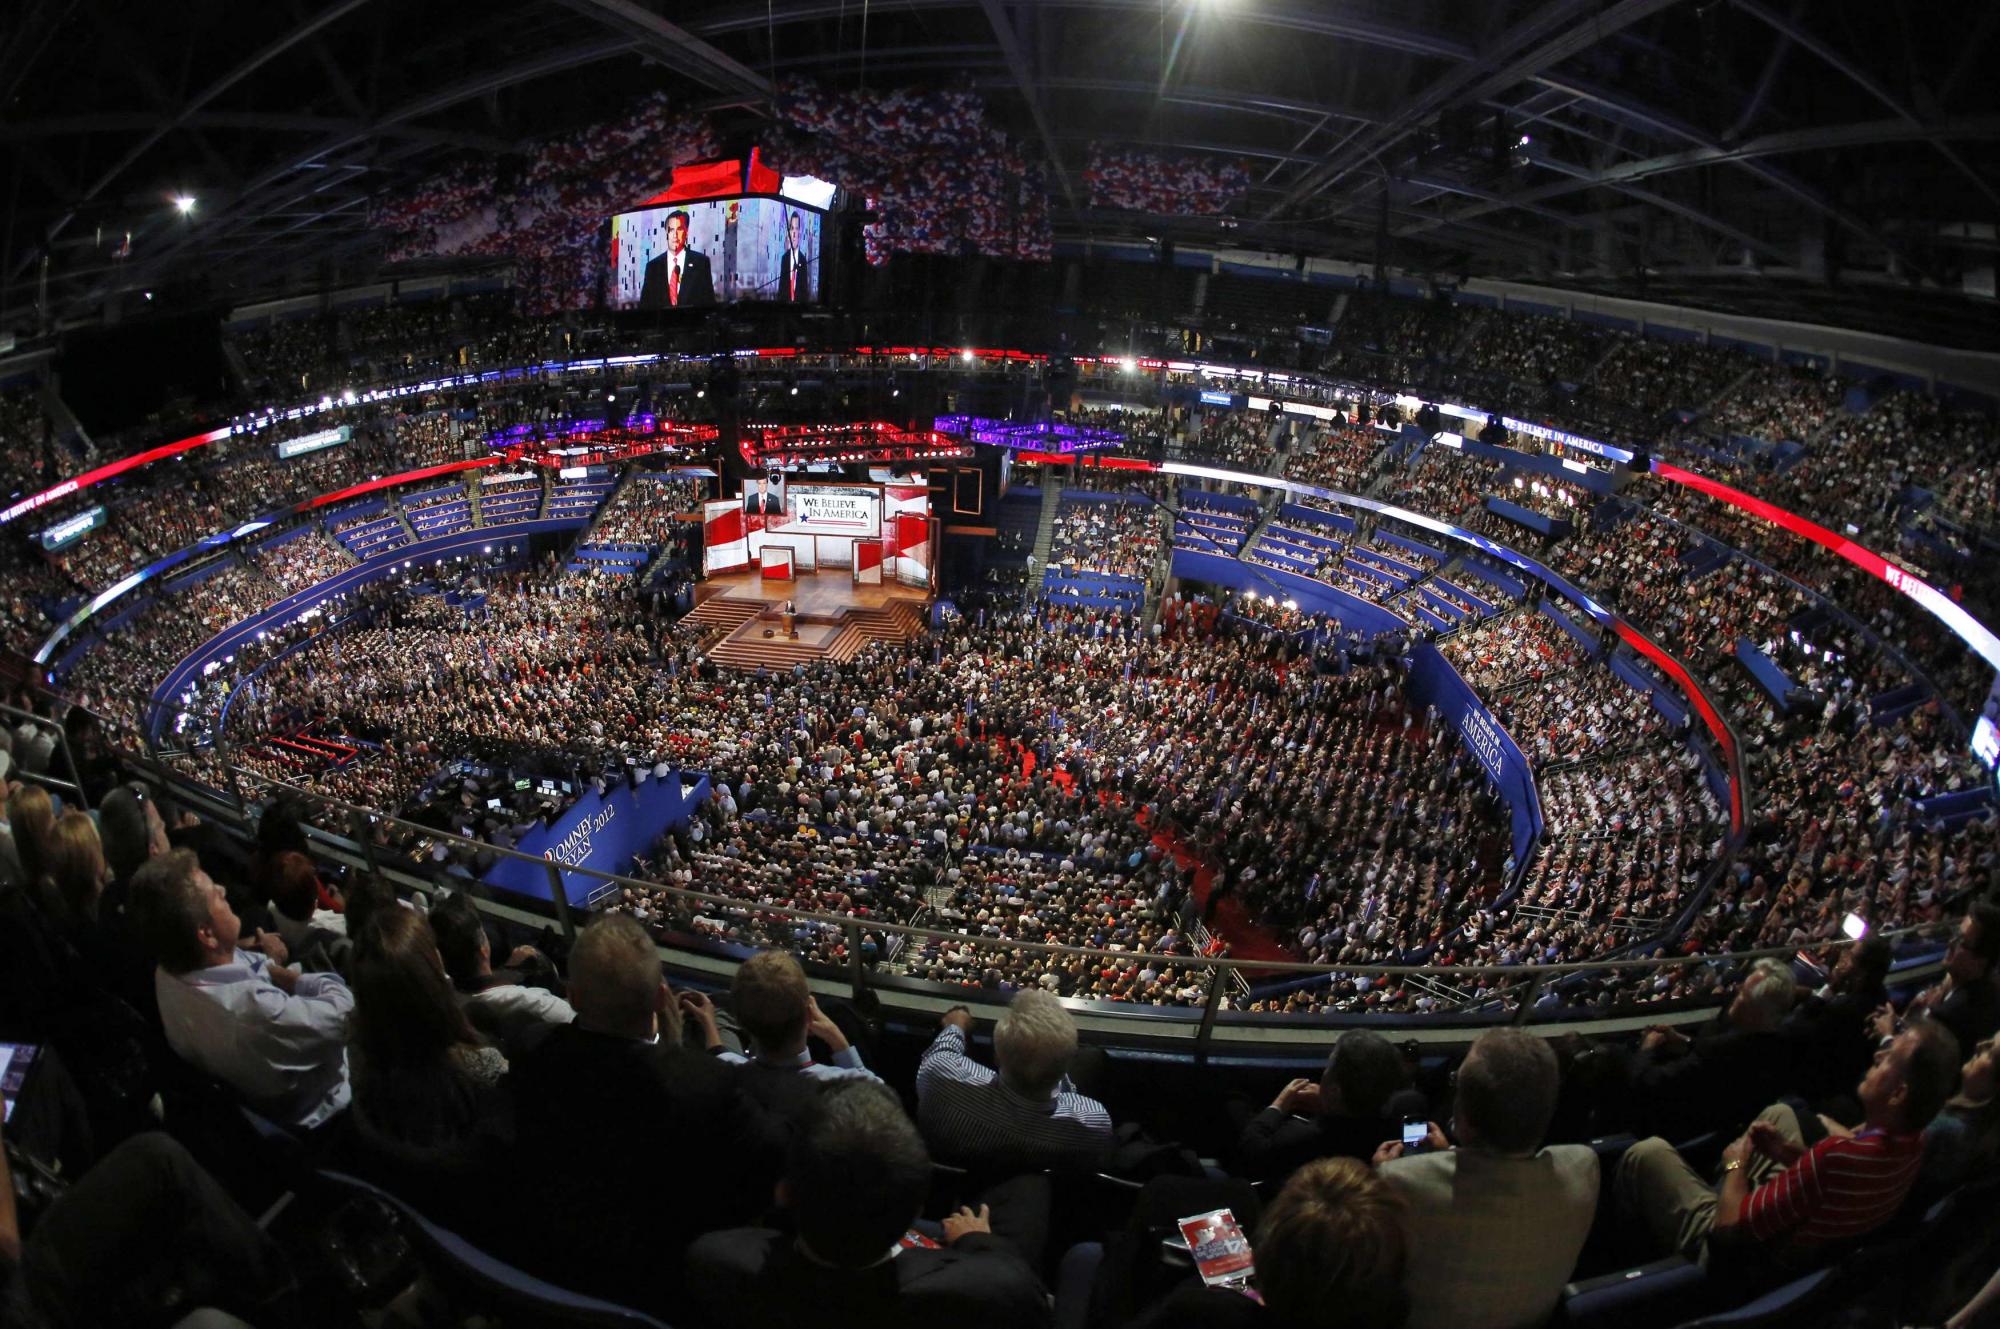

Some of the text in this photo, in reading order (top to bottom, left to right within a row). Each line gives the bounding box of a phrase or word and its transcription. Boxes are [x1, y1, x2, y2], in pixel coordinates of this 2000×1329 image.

[1518, 422, 1553, 441] BELIEVE
[1554, 431, 1566, 444] IN
[1565, 433, 1605, 455] AMERICA
[803, 497, 857, 509] WE BELIEVE
[809, 507, 869, 520] IN AMERICA
[1885, 564, 1903, 588] WE
[1480, 716, 1496, 742] BELIEVE
[1462, 712, 1502, 777] AMERICA
[593, 803, 615, 833] 2012
[544, 813, 593, 862] ROMNEY
[563, 836, 592, 867] RYAN
